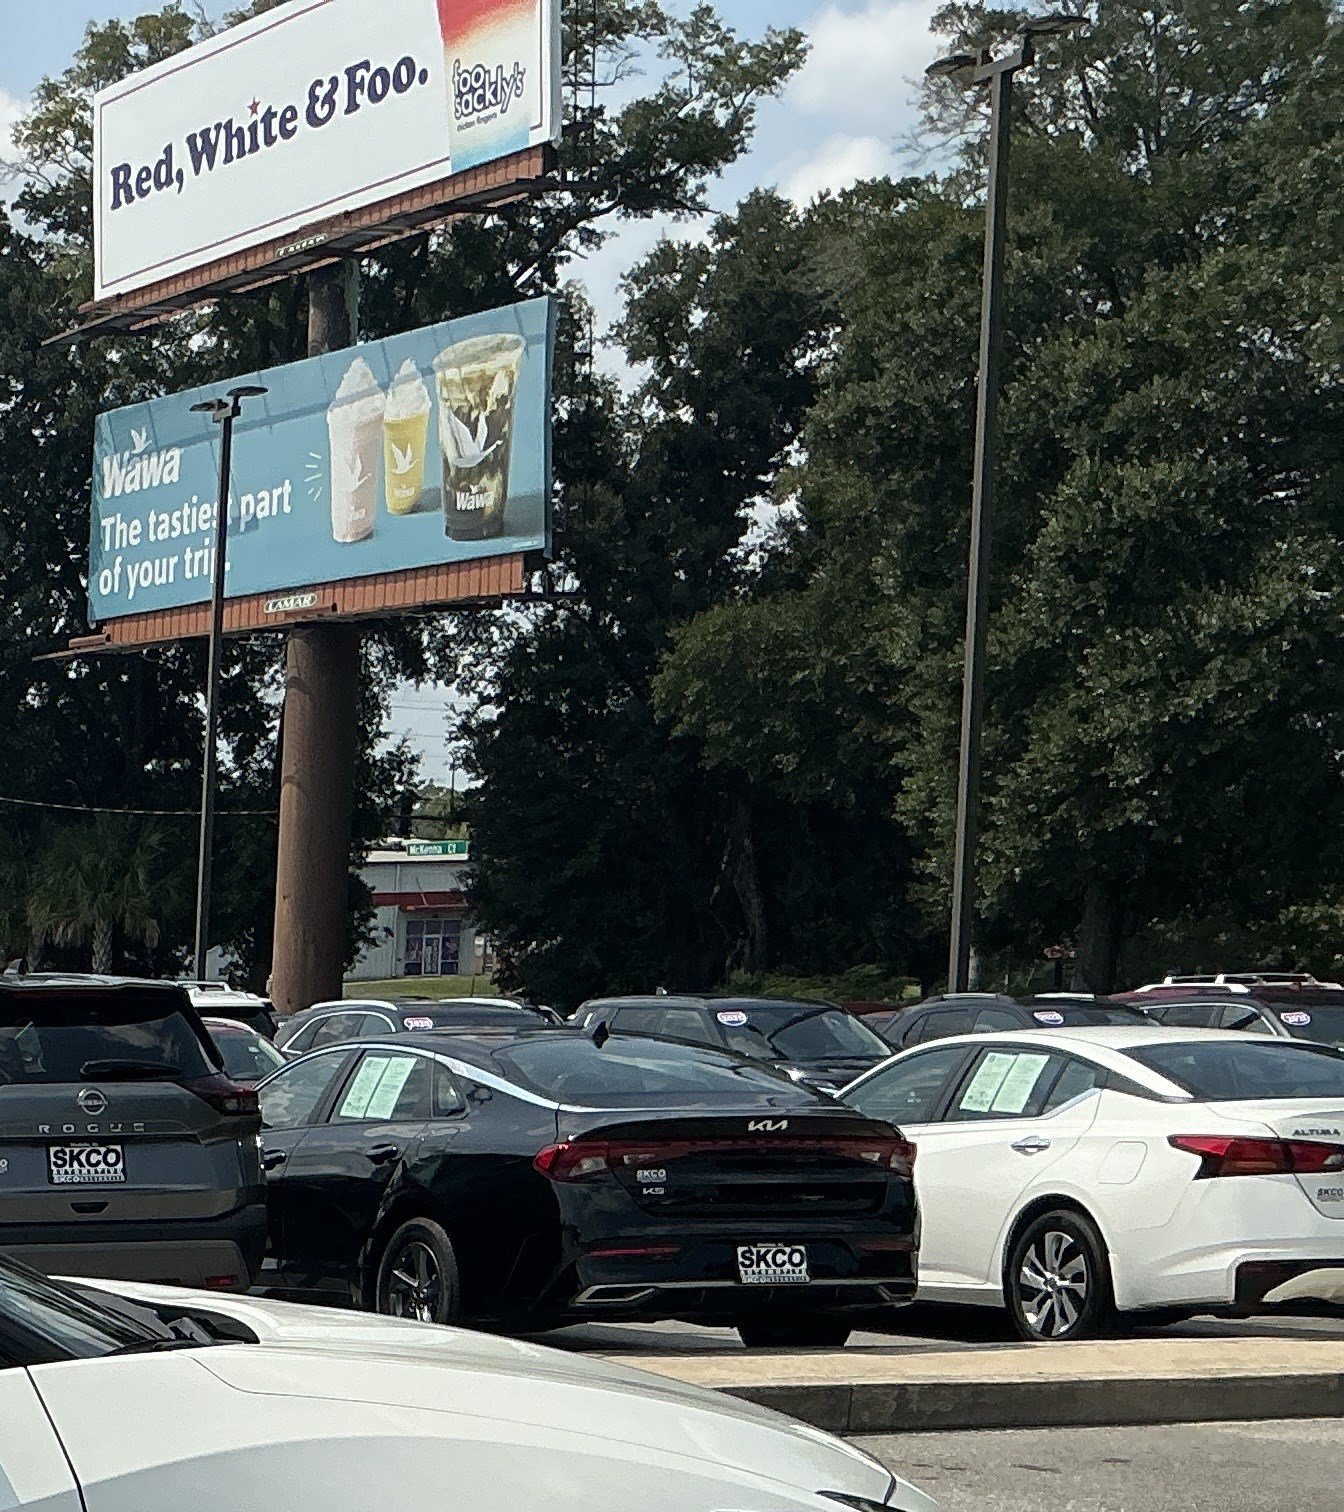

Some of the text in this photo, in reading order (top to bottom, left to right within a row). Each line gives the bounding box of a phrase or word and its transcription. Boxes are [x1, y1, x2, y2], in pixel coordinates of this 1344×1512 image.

[452, 58, 484, 92] foo
[454, 62, 526, 119] sackly's
[110, 55, 429, 211] Red, White & Foo.
[103, 448, 182, 499] Wawa
[456, 491, 495, 511] Wawa
[101, 513, 142, 551] The
[240, 479, 292, 533] part
[99, 555, 123, 596] of
[127, 555, 179, 600] your
[267, 594, 312, 612] LAMAR
[38, 1122, 145, 1134] ROGUE
[1293, 1128, 1341, 1136] ALTIMA
[52, 1148, 121, 1168] SKCO
[739, 1248, 805, 1269] SKCO
